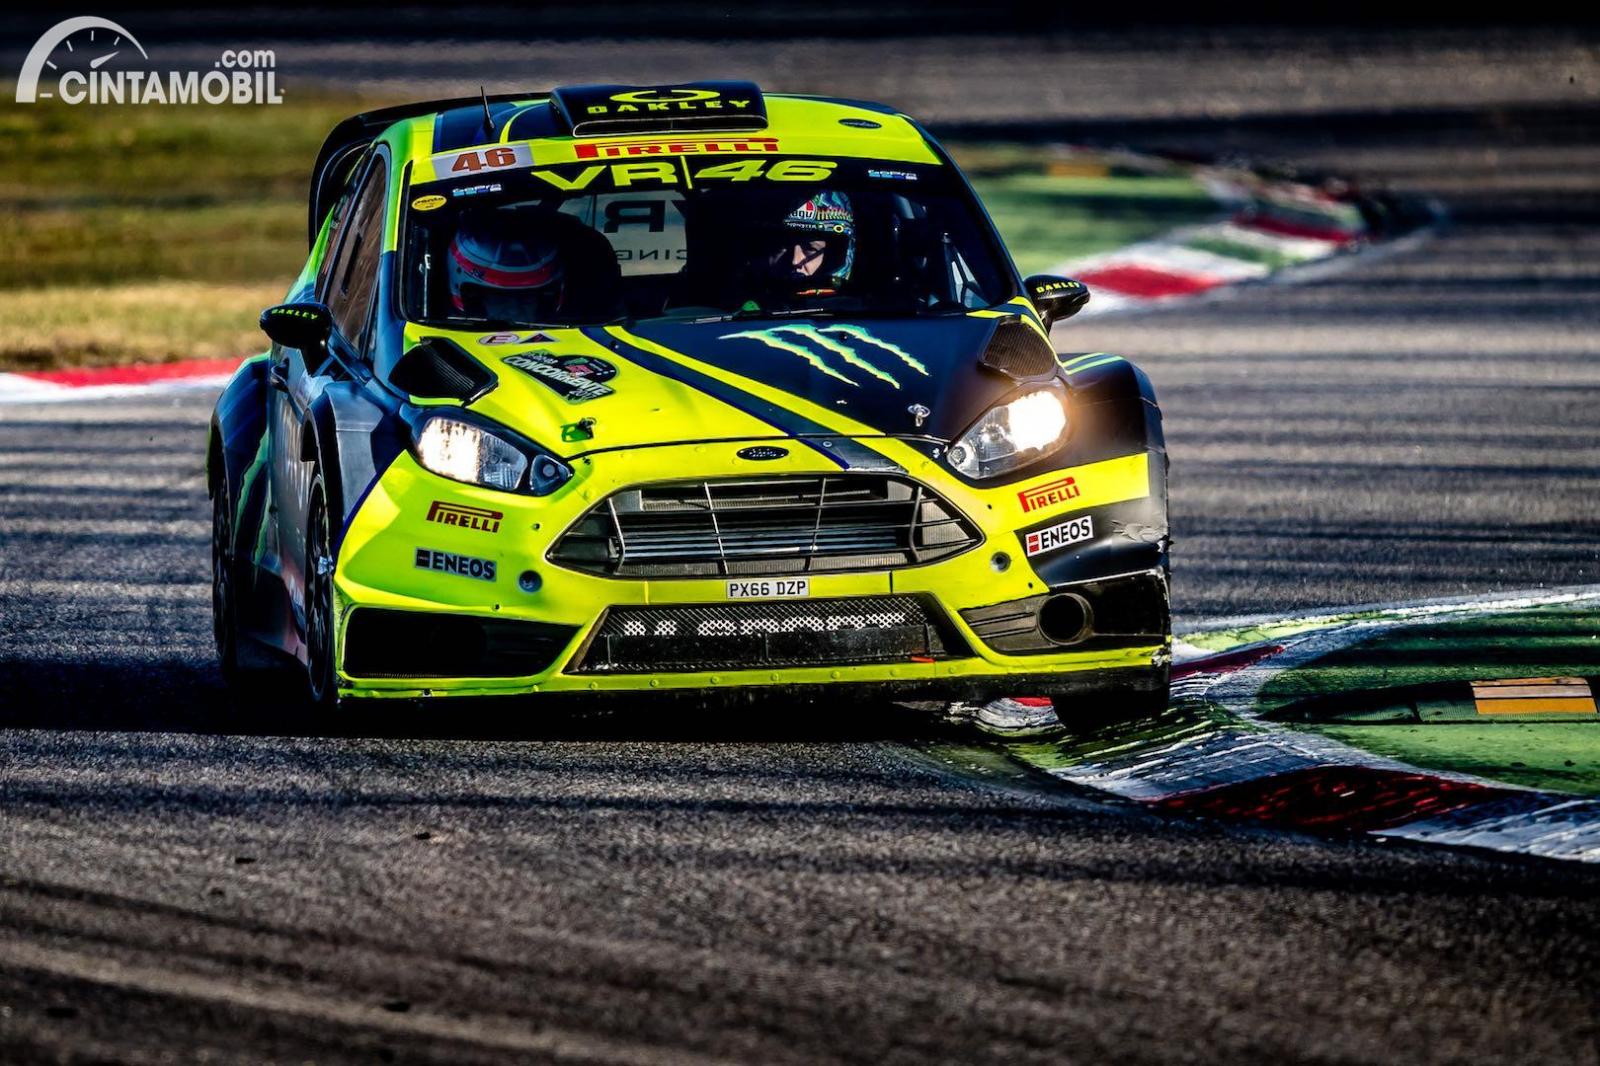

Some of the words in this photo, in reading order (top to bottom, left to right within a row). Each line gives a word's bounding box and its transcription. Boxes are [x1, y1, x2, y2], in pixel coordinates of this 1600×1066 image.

[587, 100, 750, 114] OAKLEY
[452, 147, 516, 172] 46
[574, 137, 777, 160] PIRELLI
[694, 159, 838, 182] 46
[1036, 281, 1080, 294] OAKLEY
[1017, 476, 1081, 513] PIRELLI
[426, 500, 504, 534] PIRELLI
[1040, 518, 1091, 550] ENEOS
[432, 551, 496, 580] ENEOS
[729, 583, 770, 597] PX66
[776, 581, 806, 595] DZP
